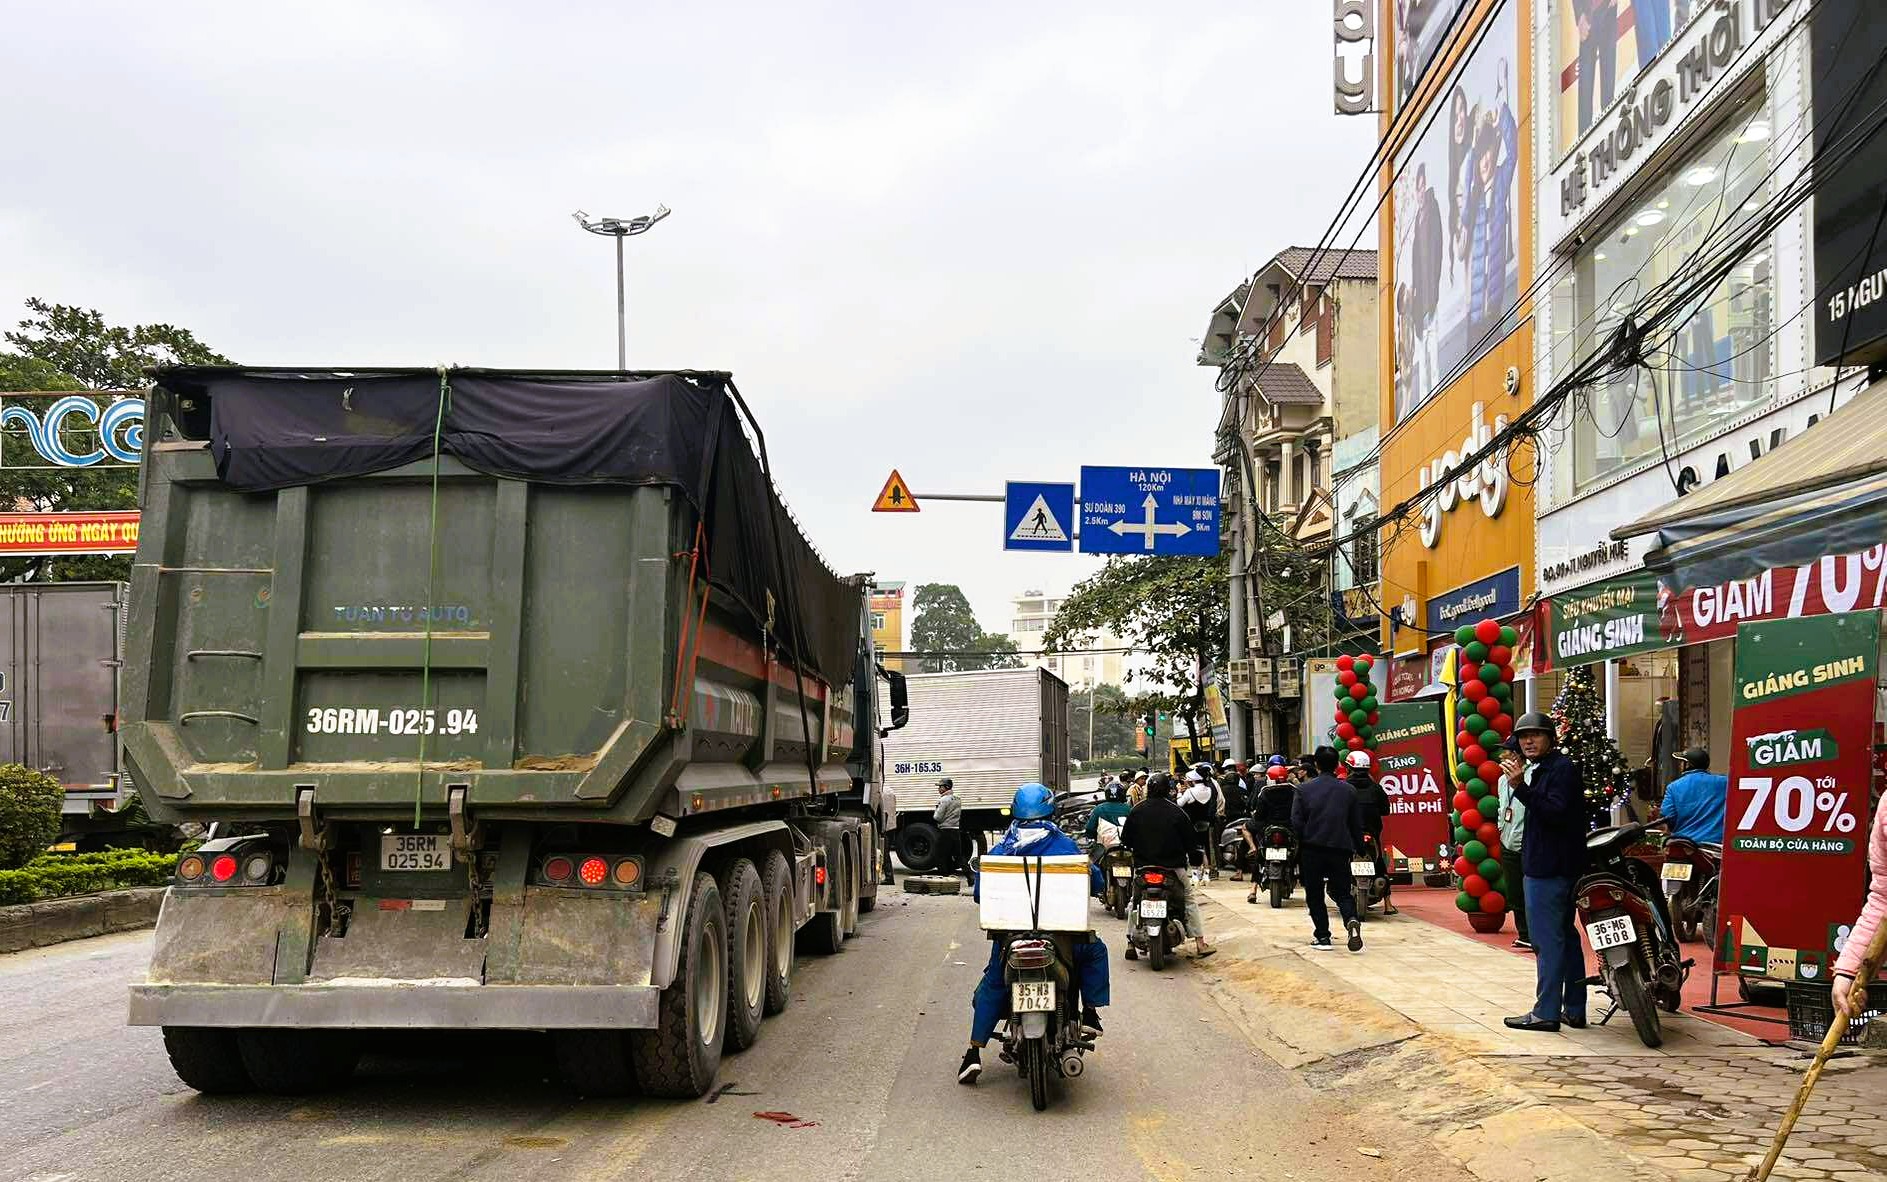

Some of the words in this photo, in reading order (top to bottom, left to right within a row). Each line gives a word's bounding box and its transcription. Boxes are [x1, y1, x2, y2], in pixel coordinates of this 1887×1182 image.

[1827, 290, 1846, 322] 15
[1129, 470, 1147, 484] HÀ
[1149, 470, 1172, 485] NỘI
[1418, 400, 1510, 550] yody
[80, 519, 118, 543] NGÀY
[1557, 619, 1602, 659] GIÁNG
[1603, 613, 1645, 650] SINH
[1742, 672, 1809, 700] GIÁNG
[1812, 655, 1866, 684] SINH
[1409, 722, 1436, 736] SINH
[1754, 735, 1823, 766] GIẢM
[894, 762, 942, 775] 36H-165.35
[1387, 756, 1417, 770] TẶNG
[1379, 767, 1440, 796] QUÀ
[1815, 776, 1836, 790] TỚI
[1418, 798, 1443, 814] PHÍ
[1736, 775, 1857, 834] 70%
[394, 836, 437, 852] 36RM
[1739, 839, 1767, 850] TOÀN
[1769, 838, 1785, 852] BỘ
[1786, 838, 1810, 851] CỬA
[1812, 839, 1845, 851] HÀNG
[387, 853, 444, 869] 025.94
[1593, 918, 1627, 936] 36-M6
[1597, 930, 1630, 947] 1608
[1018, 997, 1051, 1011] 7042
